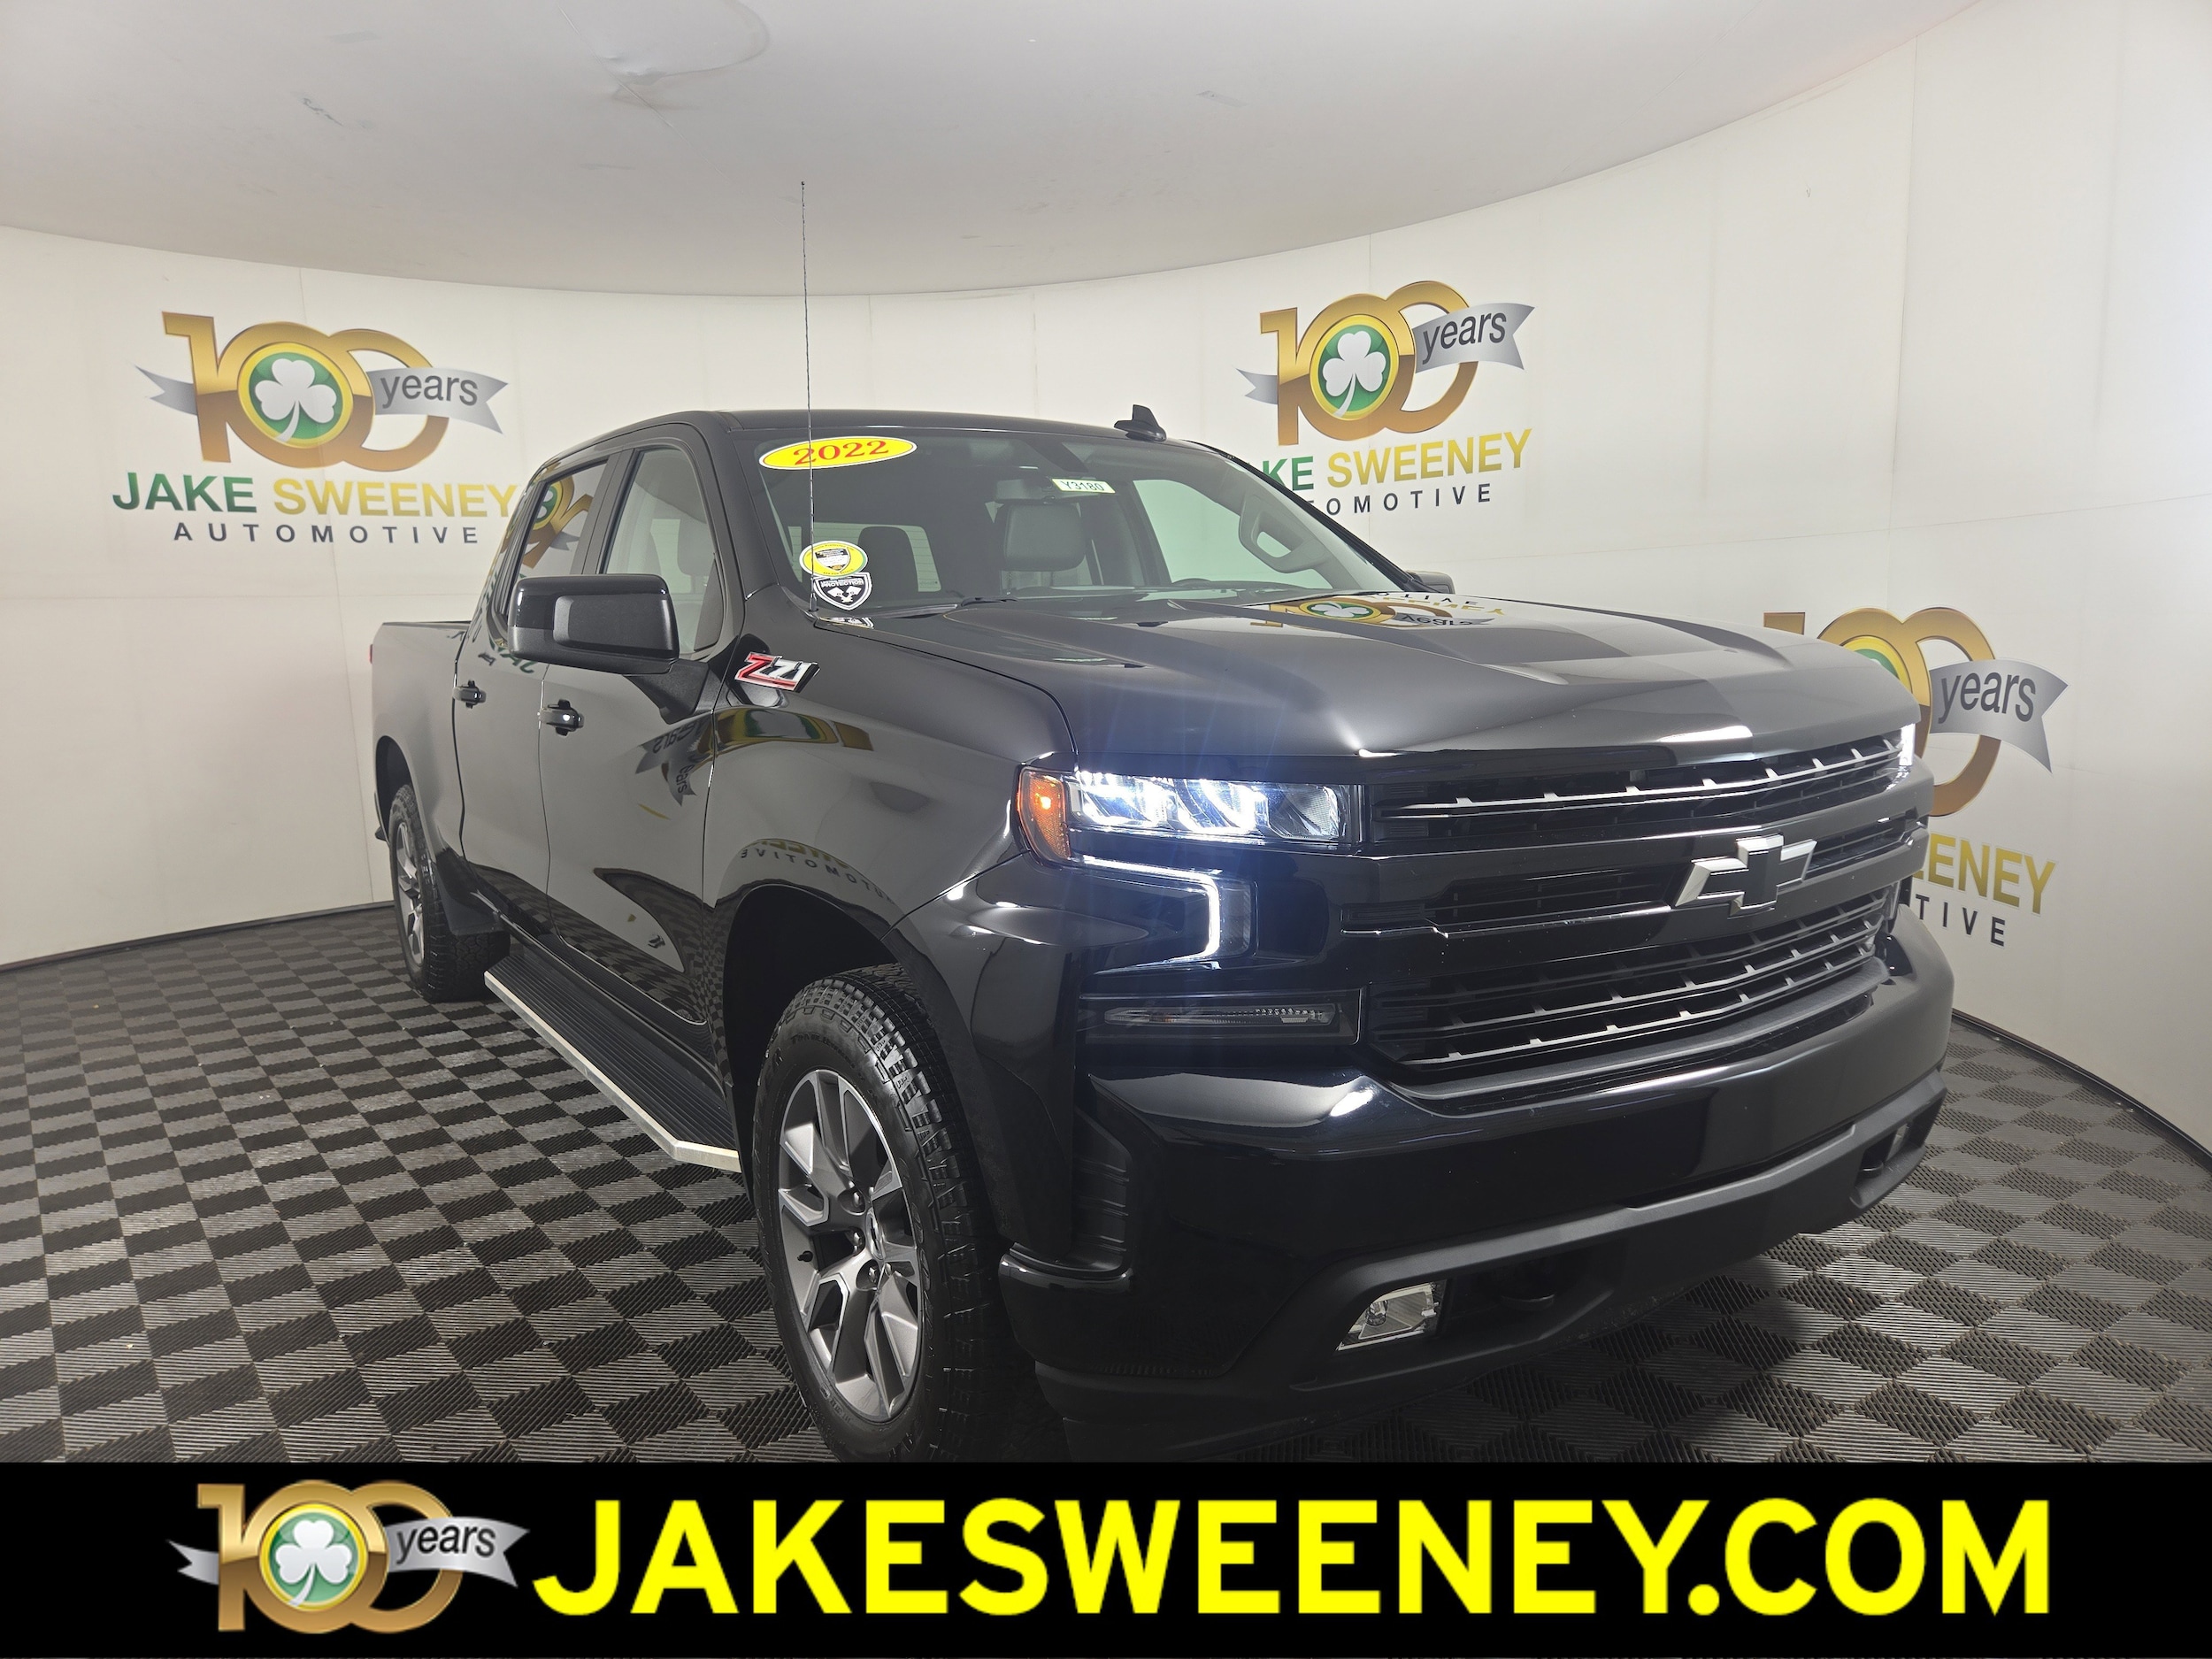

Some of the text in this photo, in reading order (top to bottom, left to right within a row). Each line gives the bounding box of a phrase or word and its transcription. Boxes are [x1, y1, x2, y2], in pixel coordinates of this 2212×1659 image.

[1422, 311, 1508, 365] years
[380, 373, 479, 409] years
[794, 440, 889, 465] 2022
[1263, 428, 1532, 491] KE SWEENEY
[112, 472, 518, 518] JAKE SWEENEY
[1059, 480, 1105, 491] Y3180
[1325, 483, 1490, 516] OMOTIVE
[173, 522, 479, 544] AUTOMOTIVE
[1937, 672, 2037, 722] years
[1927, 833, 2056, 915] ENEY
